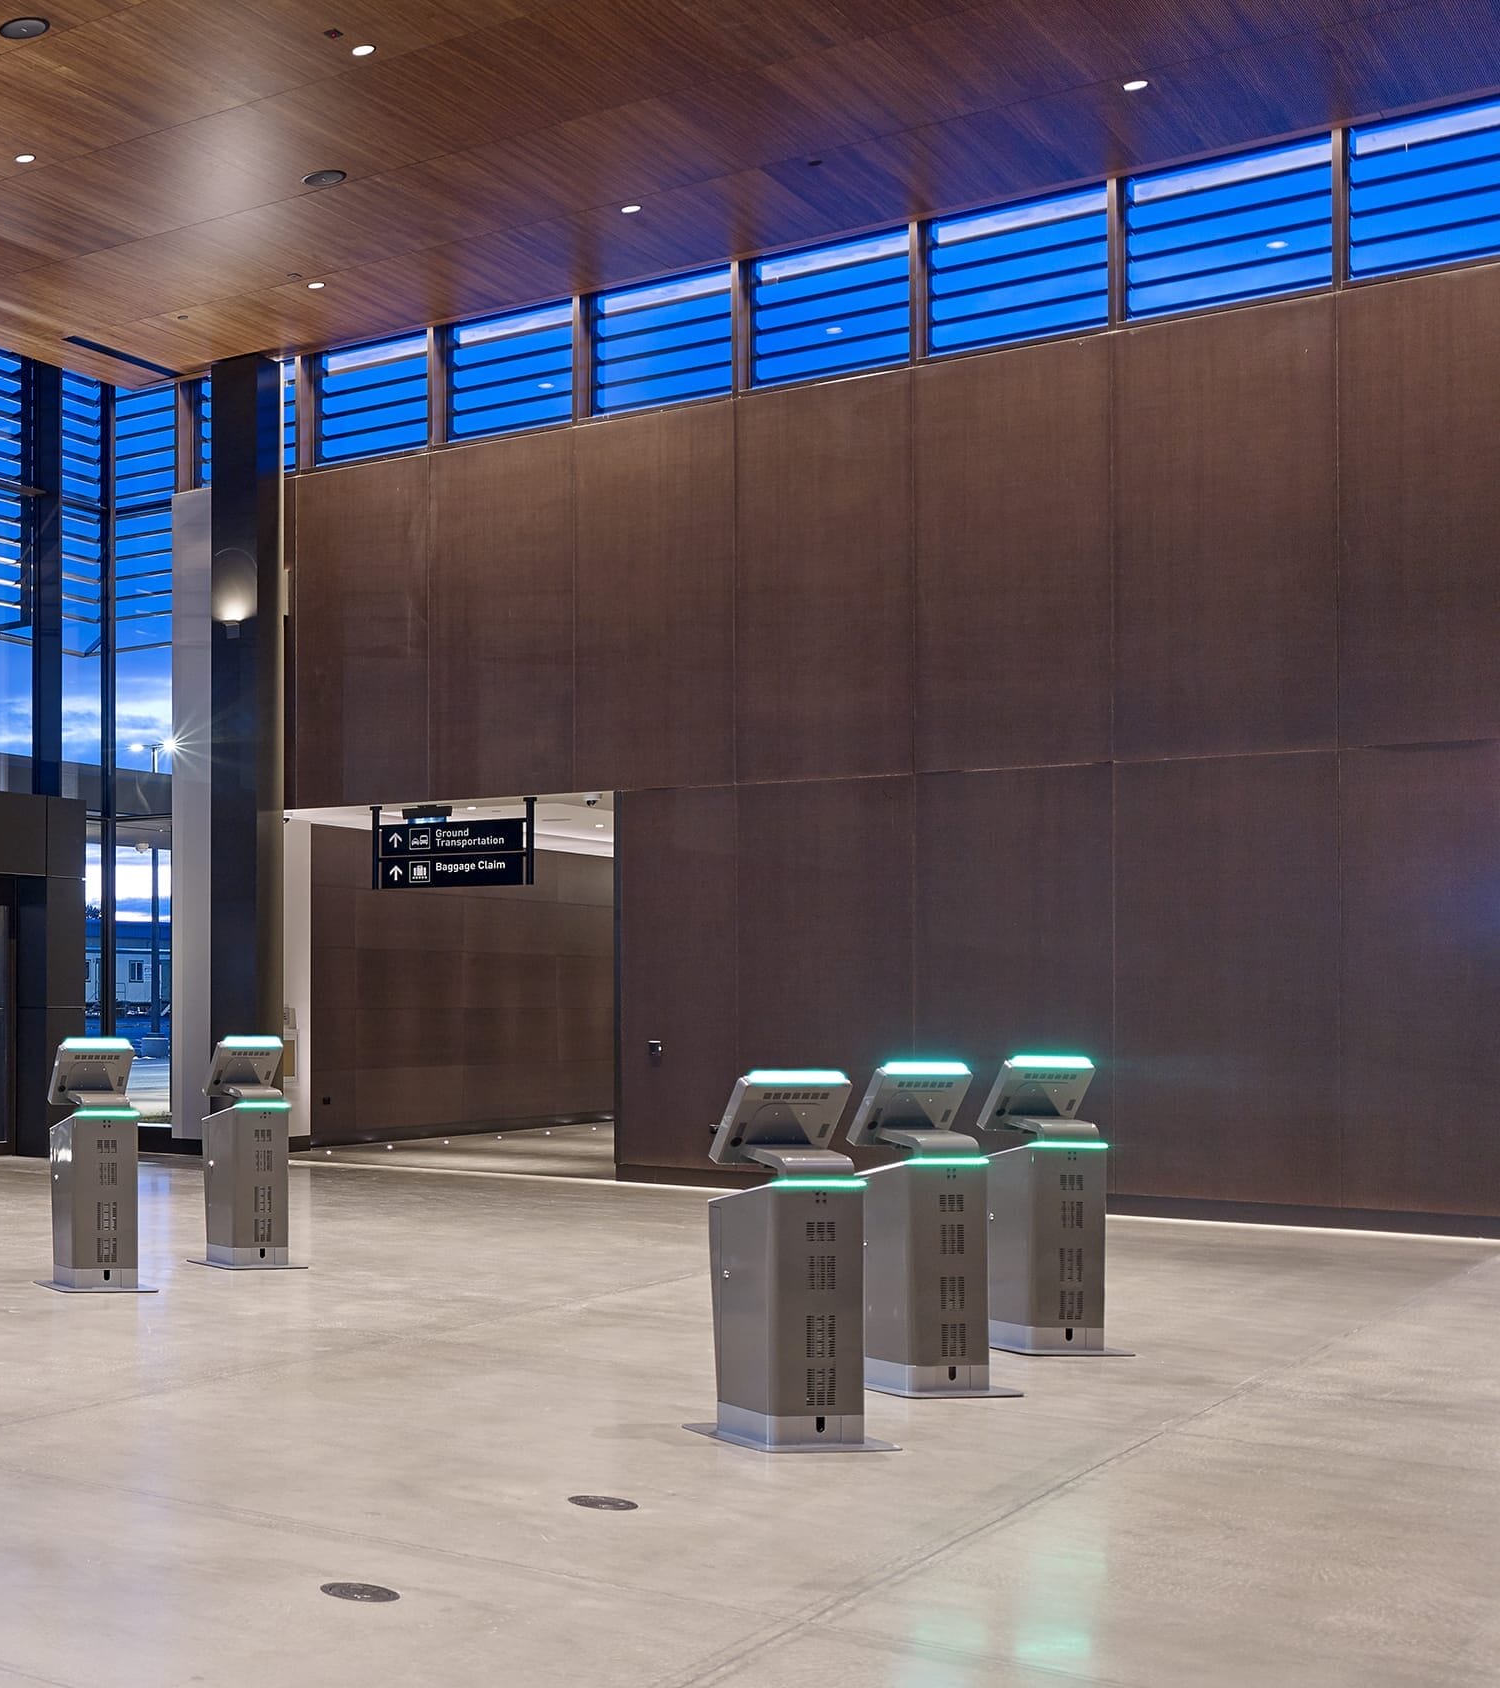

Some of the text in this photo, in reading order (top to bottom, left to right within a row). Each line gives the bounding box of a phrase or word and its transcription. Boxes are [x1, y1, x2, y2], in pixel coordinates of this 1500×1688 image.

[435, 827, 469, 837] Ground
[435, 836, 505, 848] Transportation
[435, 860, 506, 873] Baggage Claim
